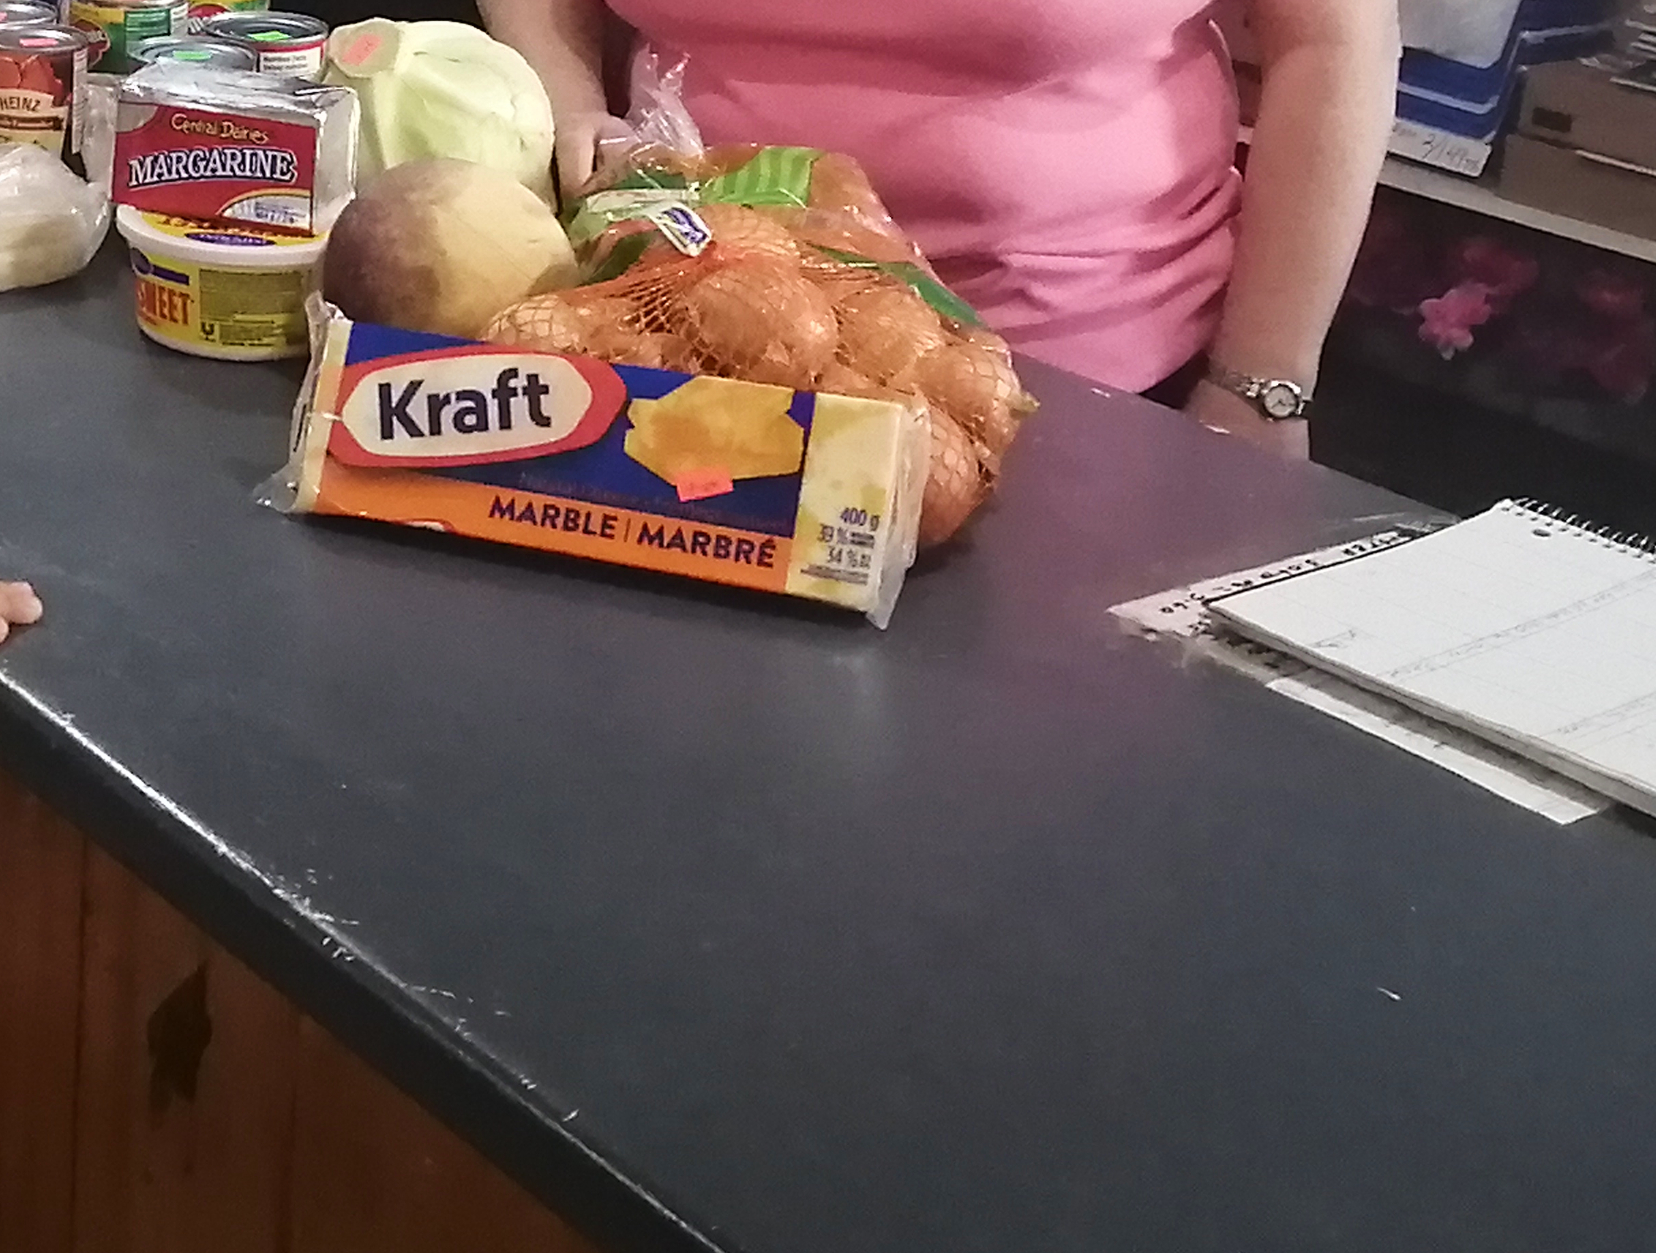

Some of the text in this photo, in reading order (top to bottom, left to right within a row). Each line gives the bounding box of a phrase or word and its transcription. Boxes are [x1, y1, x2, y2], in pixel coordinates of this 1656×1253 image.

[0, 95, 41, 112] HEINZ
[171, 113, 270, 145] Central Dairies
[128, 147, 297, 189] MARGARINE
[376, 366, 553, 442] Kraft
[488, 494, 619, 542] MARBLE
[636, 521, 777, 569] MARBRÉ
[840, 507, 868, 527] 400
